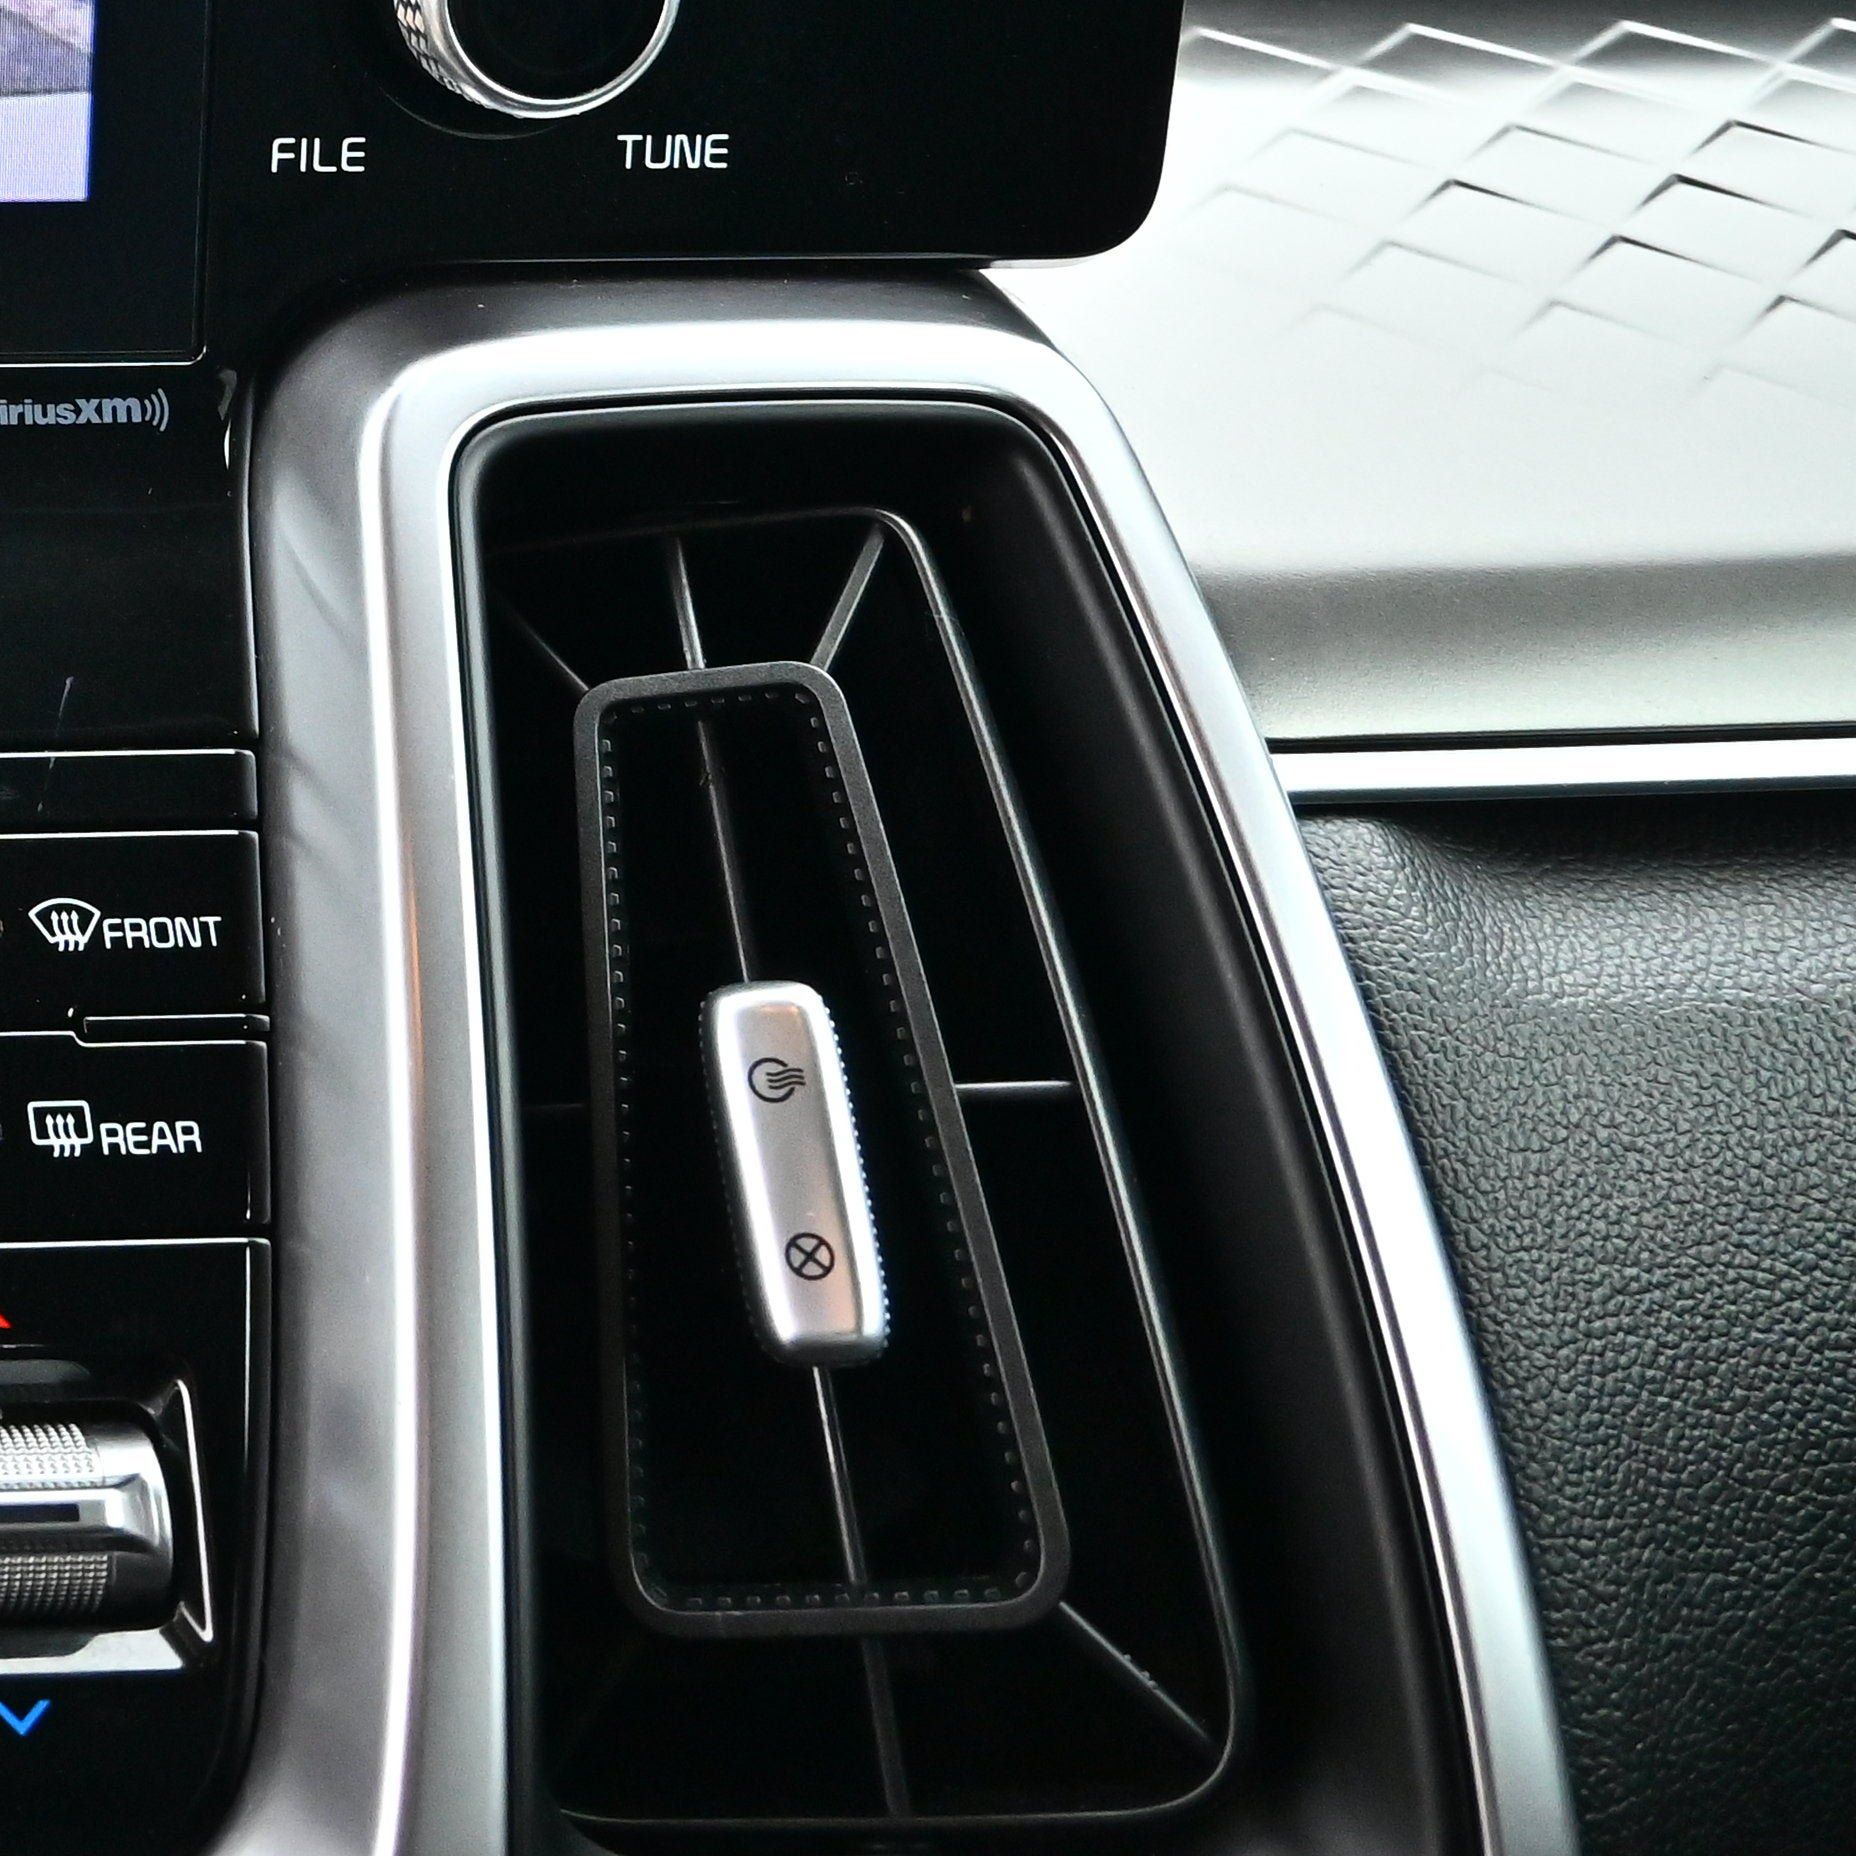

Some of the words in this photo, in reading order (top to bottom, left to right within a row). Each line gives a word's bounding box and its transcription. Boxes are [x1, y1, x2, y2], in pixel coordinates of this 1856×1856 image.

[270, 136, 367, 173] FILE
[617, 133, 729, 170] TUNE
[102, 915, 222, 949] FRONT
[99, 1120, 203, 1156] REAR
